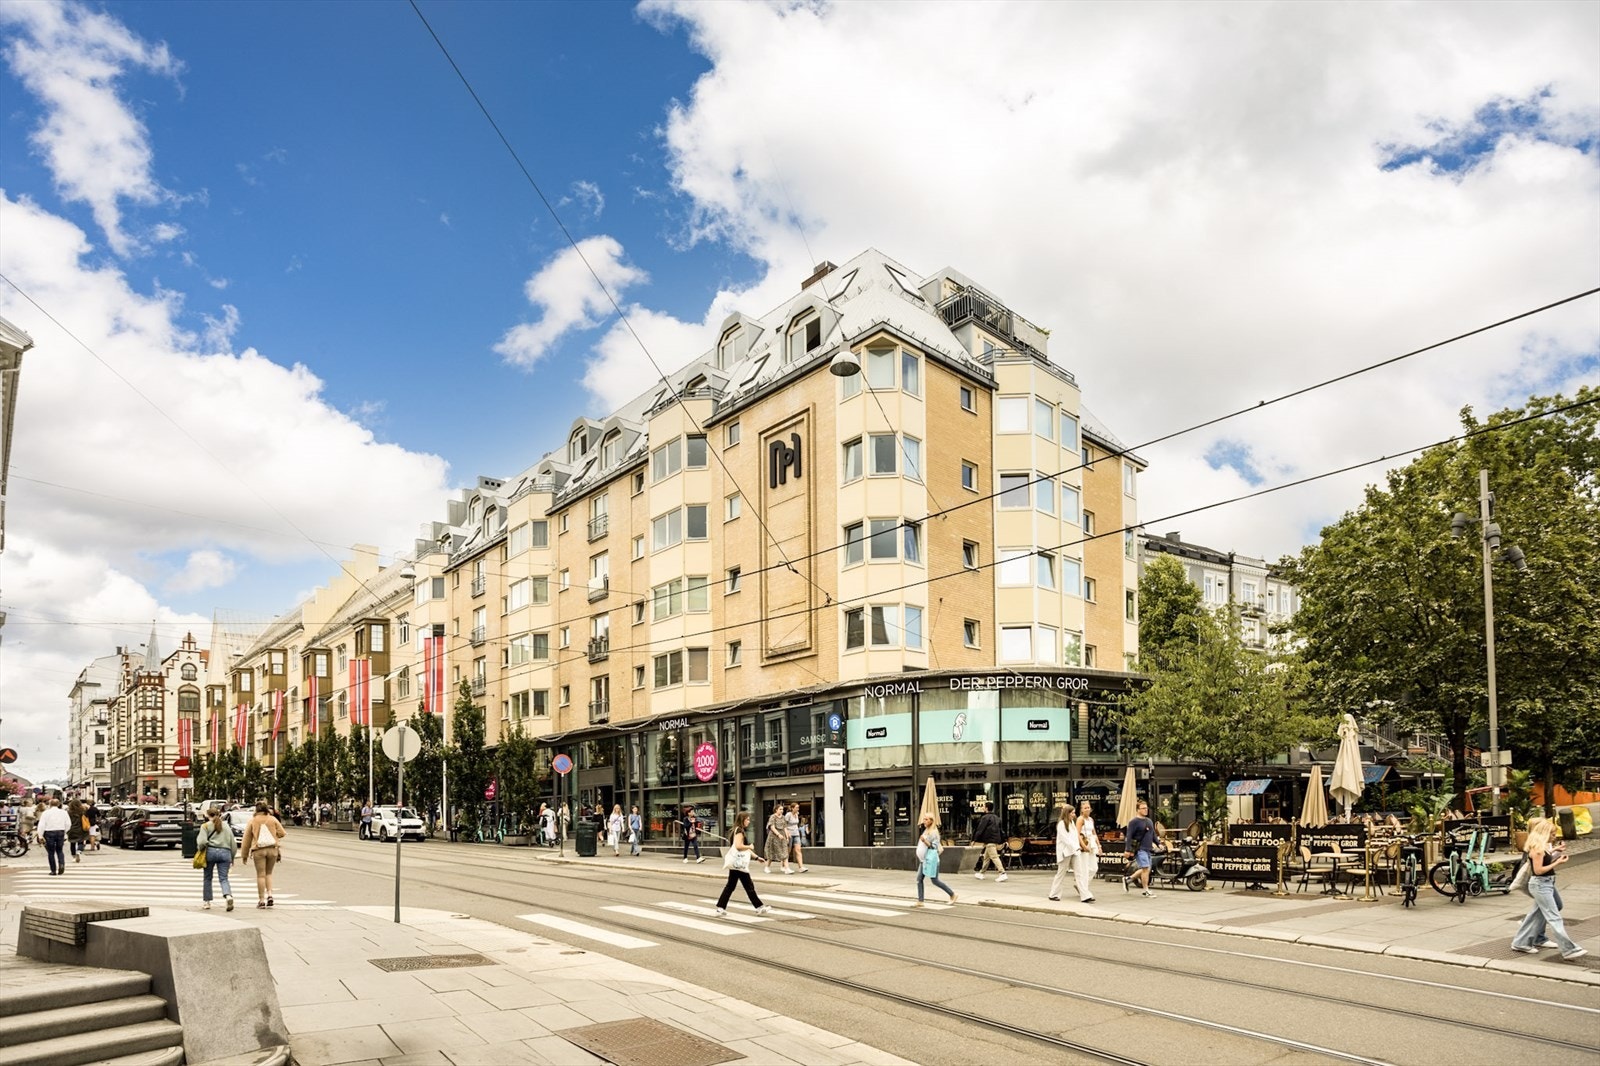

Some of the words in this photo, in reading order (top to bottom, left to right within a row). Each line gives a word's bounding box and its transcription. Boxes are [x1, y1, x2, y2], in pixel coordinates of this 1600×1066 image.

[950, 678, 981, 690] DER
[986, 676, 1052, 689] PEPPERN
[1056, 676, 1089, 690] GROR
[864, 681, 925, 699] NORMAL
[659, 718, 690, 731] NORMAL
[1242, 830, 1273, 838] INDIAN
[1261, 838, 1281, 846] FOO
[1211, 862, 1224, 870] DER
[1224, 863, 1252, 872] PEPPERN
[1252, 863, 1272, 872] GROR
